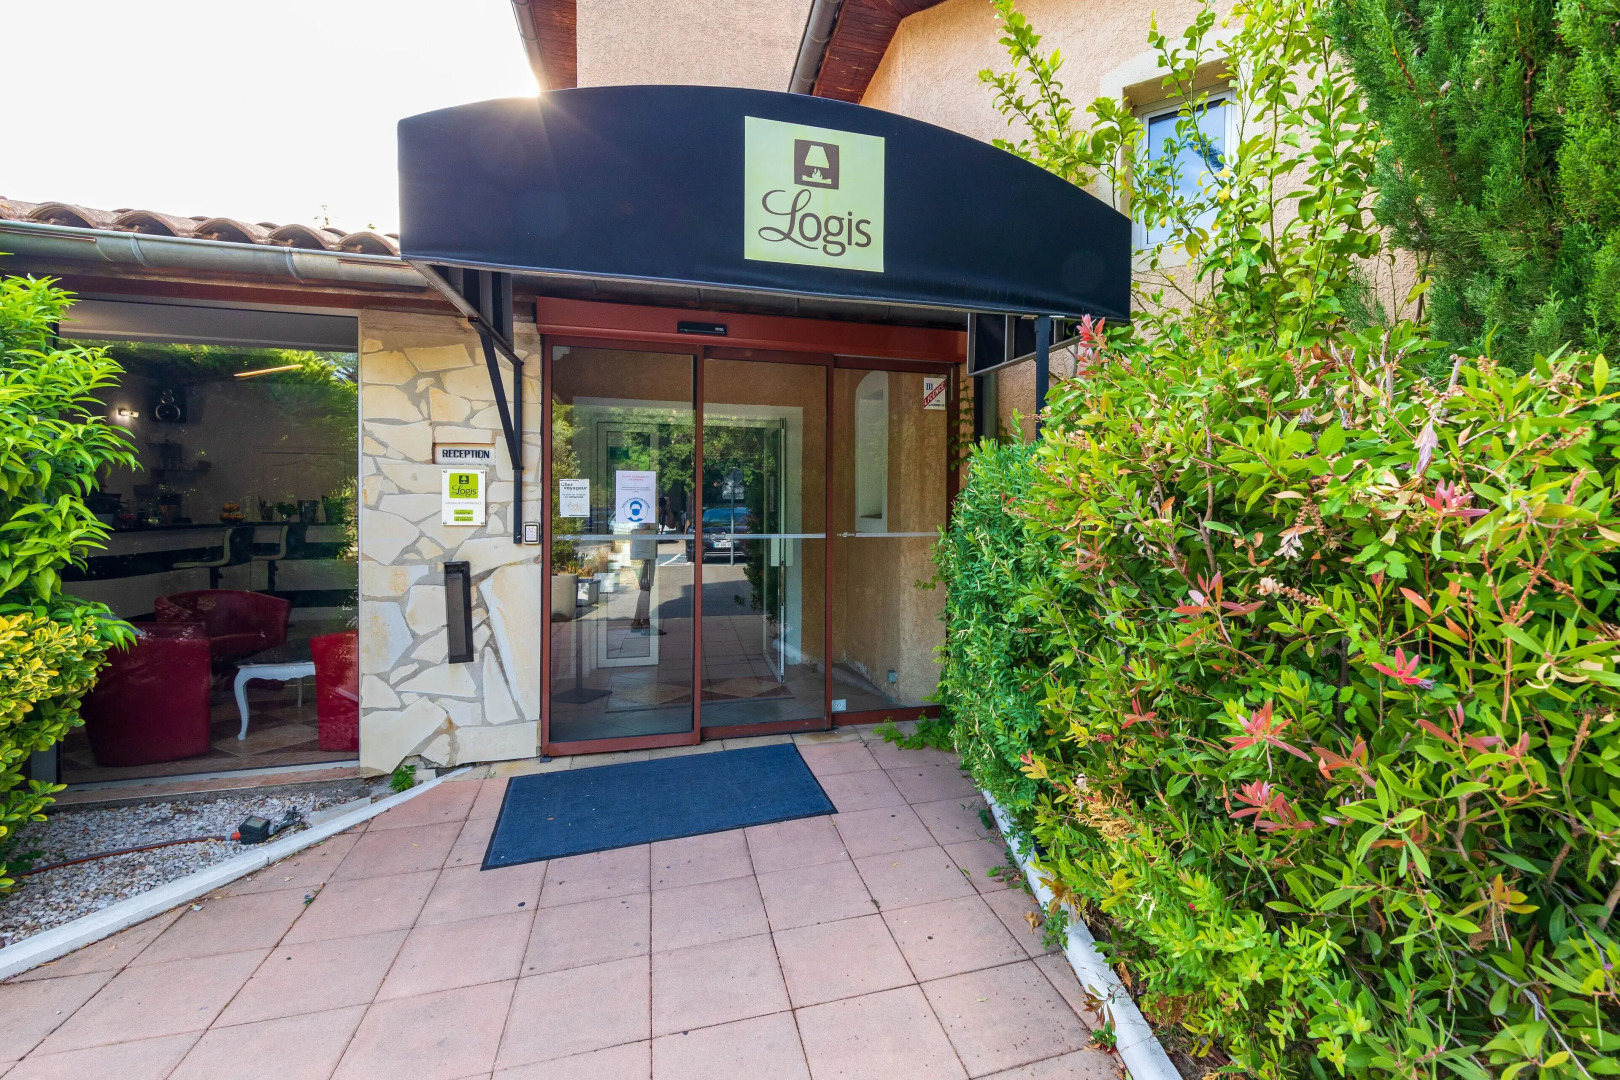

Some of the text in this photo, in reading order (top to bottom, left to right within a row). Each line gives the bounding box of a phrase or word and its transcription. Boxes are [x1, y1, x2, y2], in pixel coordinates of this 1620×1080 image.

[757, 188, 872, 257] Logis
[924, 381, 945, 405] LICENCE
[442, 449, 490, 459] RECEPTION
[451, 484, 477, 498] Logis
